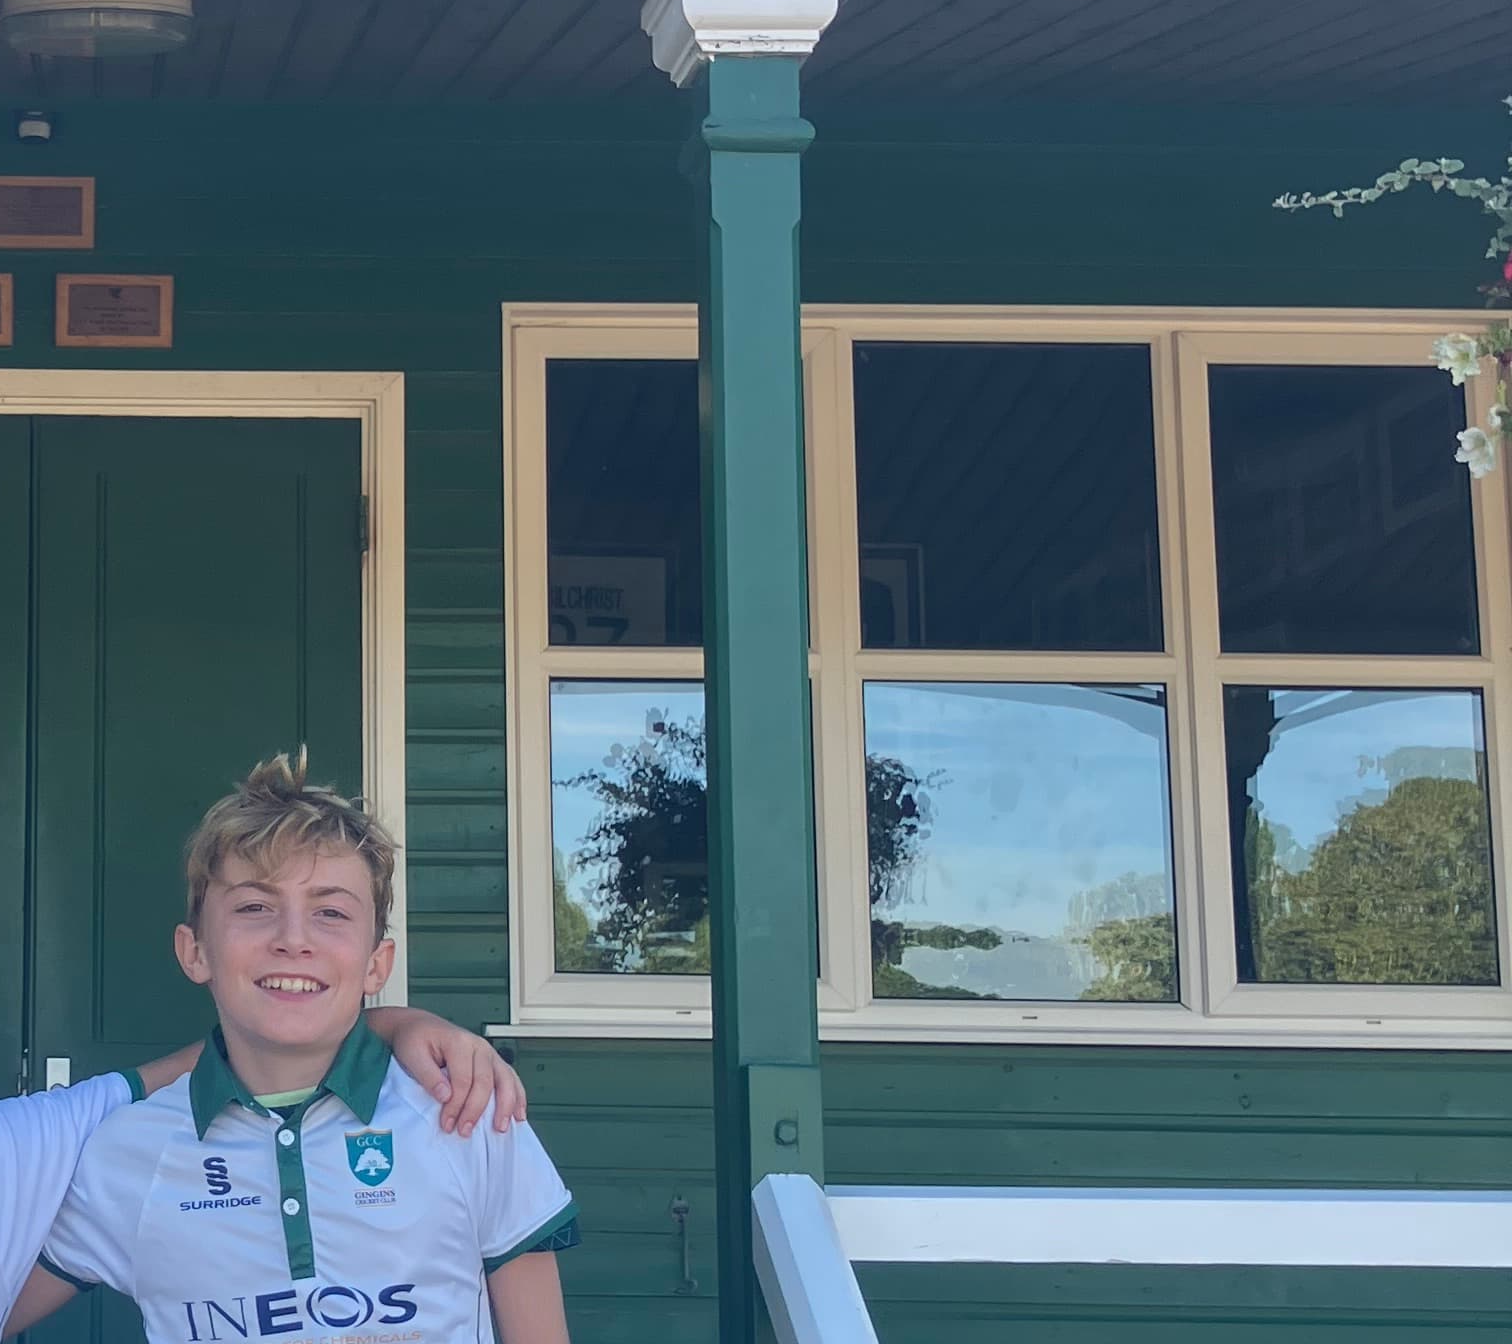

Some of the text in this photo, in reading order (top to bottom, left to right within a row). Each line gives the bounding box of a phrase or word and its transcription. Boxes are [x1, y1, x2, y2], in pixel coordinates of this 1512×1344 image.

[356, 1136, 382, 1147] GCC
[180, 1196, 262, 1211] SURRIDGE
[182, 1284, 418, 1342] INEOS
